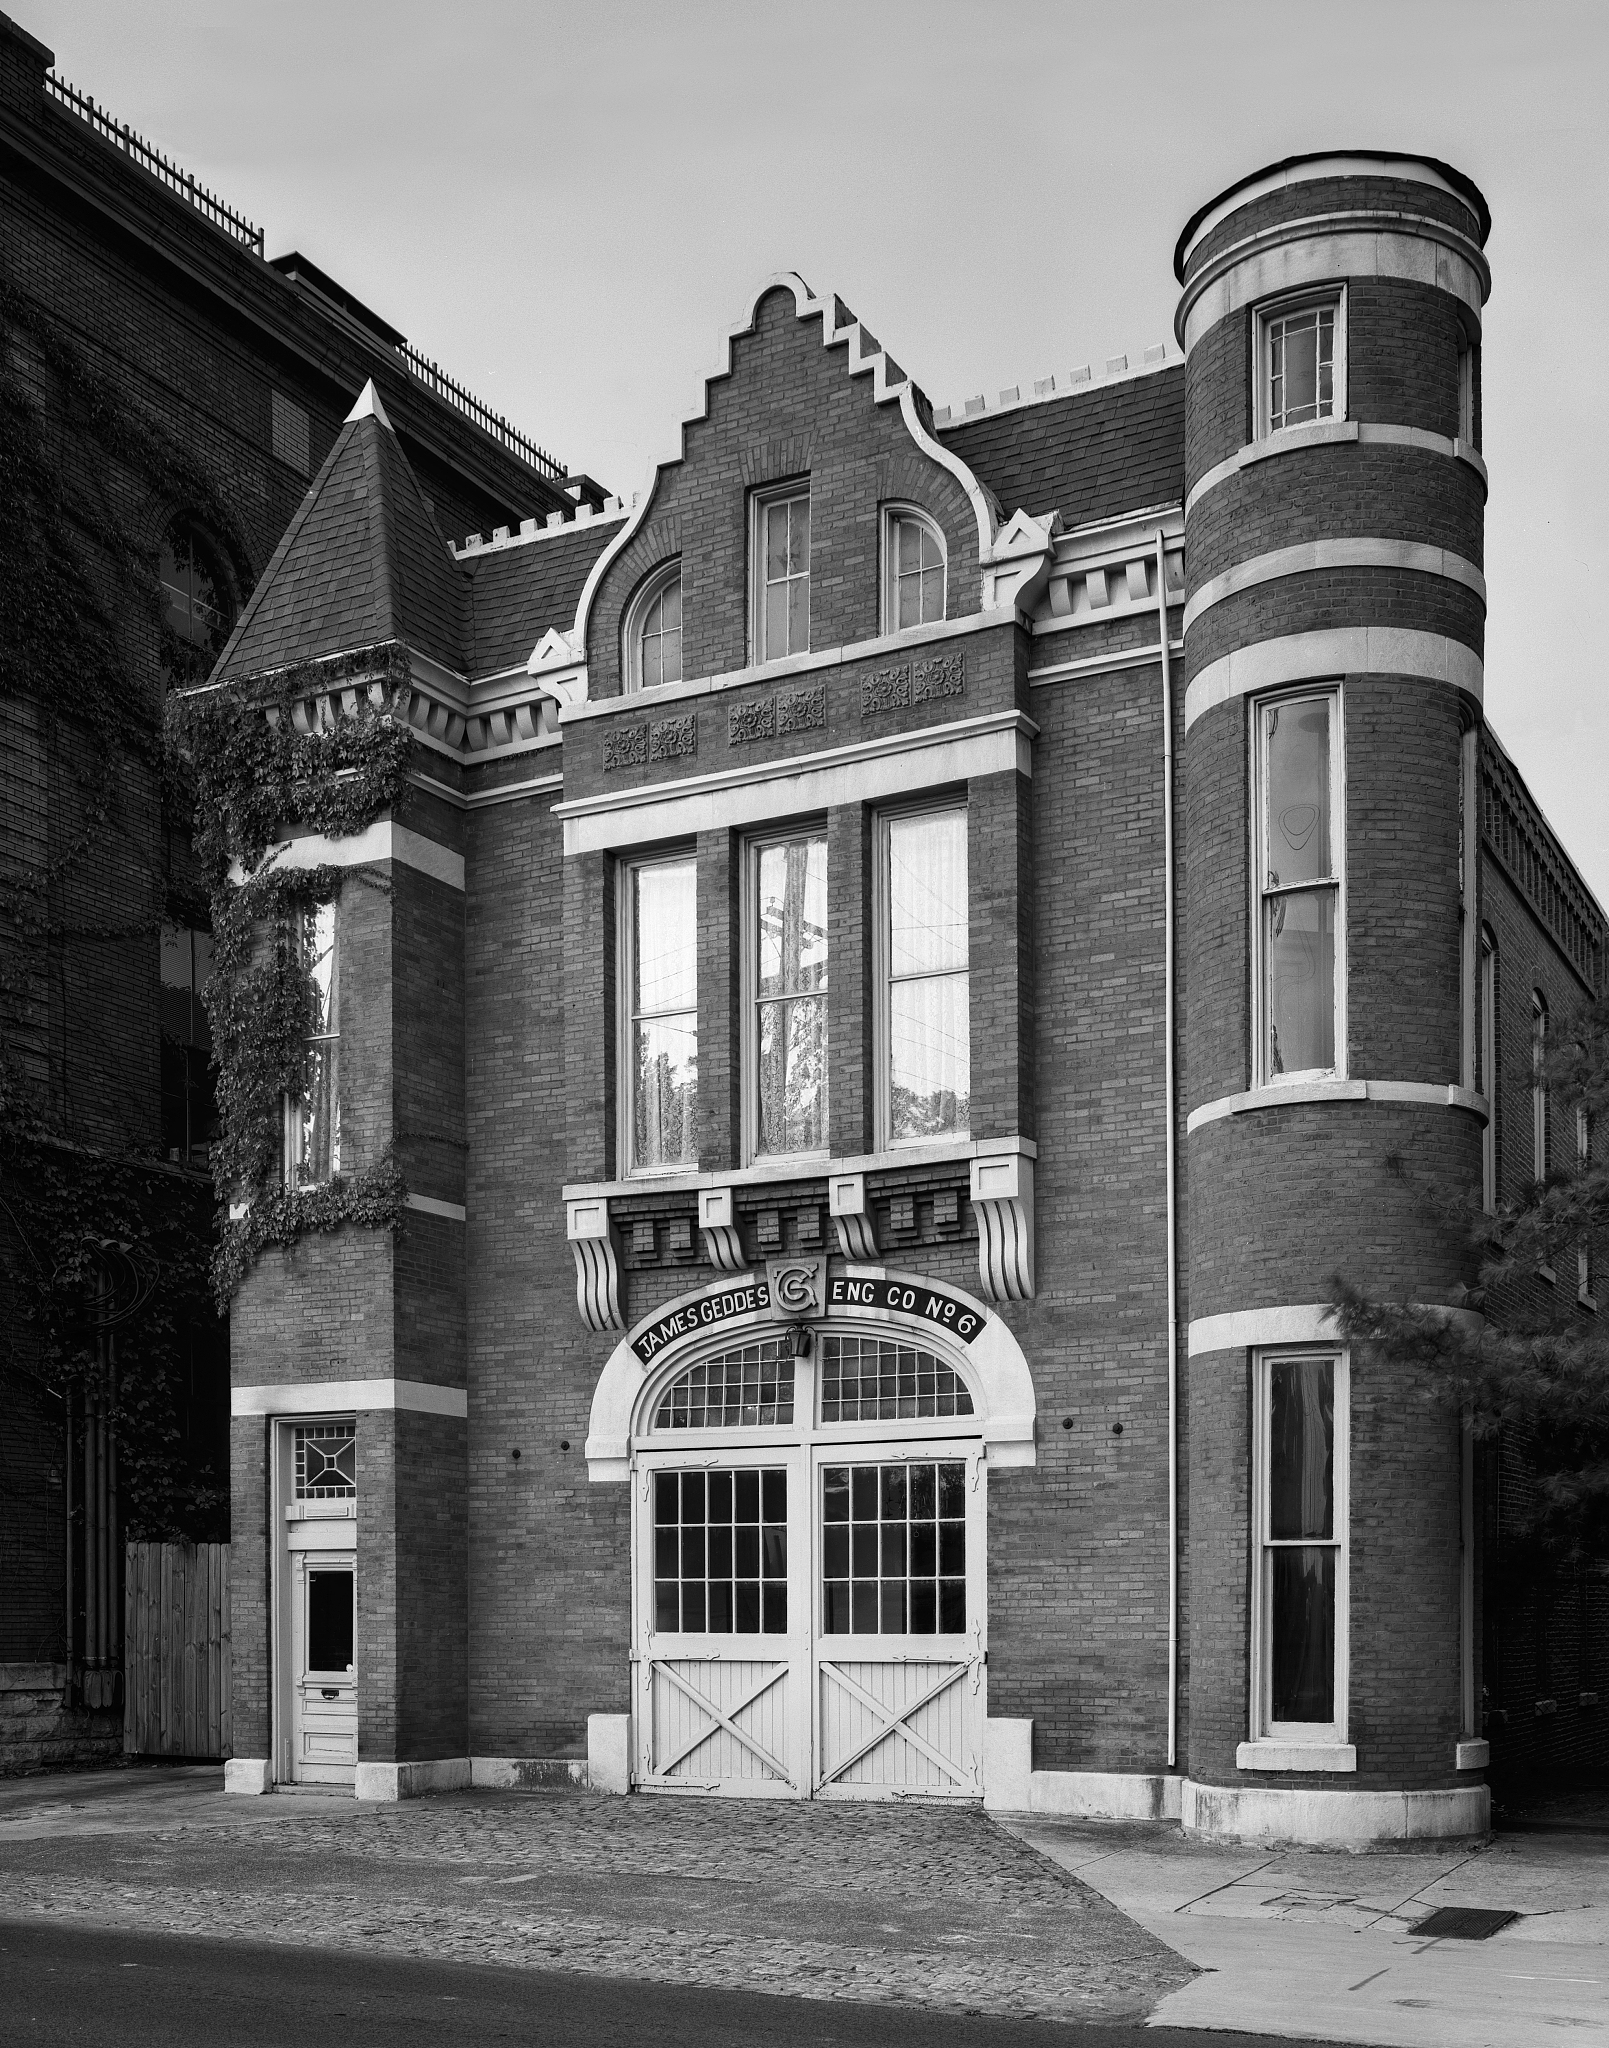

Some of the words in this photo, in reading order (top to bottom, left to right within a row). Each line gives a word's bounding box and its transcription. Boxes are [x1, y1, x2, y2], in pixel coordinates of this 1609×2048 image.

[638, 1308, 699, 1358] JAMES
[700, 1286, 768, 1322] GEDDES
[832, 1281, 875, 1303] ENG
[887, 1286, 916, 1309] CO
[957, 1314, 977, 1334] 6
